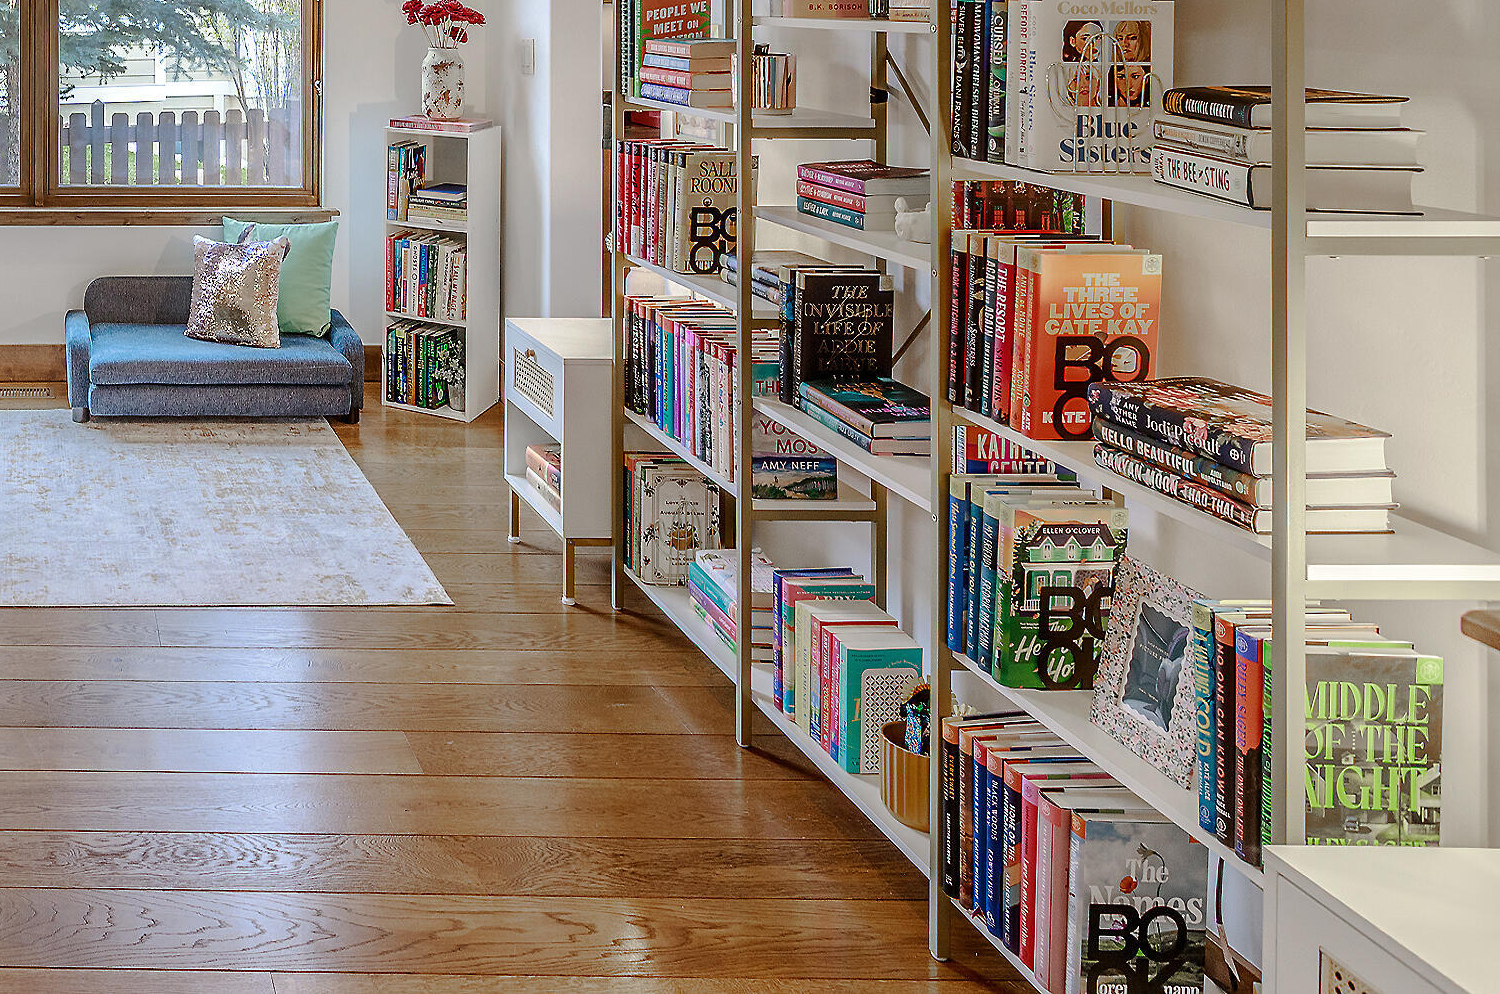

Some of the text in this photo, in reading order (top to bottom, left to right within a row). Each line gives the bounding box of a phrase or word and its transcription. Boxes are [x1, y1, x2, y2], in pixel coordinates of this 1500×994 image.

[646, 0, 707, 22] PEOPLE WE
[828, 3, 863, 11] BORISON
[958, 5, 966, 34] SILVER
[1057, 0, 1158, 15] Coco Mellors
[653, 19, 699, 36] MEET ON
[972, 4, 982, 63] MADWOMAN
[1020, 4, 1028, 40] BEFORE
[993, 15, 1004, 66] CURSED
[1019, 48, 1027, 83] FORGET
[972, 64, 981, 106] CHELSEA
[953, 75, 963, 139] DANI FRANCIS
[1185, 98, 1235, 120] PERCIVAL EVERETT
[1076, 113, 1138, 139] Blue
[1059, 138, 1152, 164] Sisters
[700, 161, 737, 177] SALL
[1167, 157, 1230, 192] THE BEE STING
[691, 177, 738, 194] ROON
[986, 259, 996, 292] AGAIN
[1082, 272, 1121, 287] THE
[831, 285, 869, 300] THE
[994, 267, 1008, 343] THE RESORT
[1063, 287, 1139, 303] THREE
[804, 303, 893, 318] INVISIBLE
[984, 306, 995, 338] AGAIN
[1049, 303, 1150, 319] LIVES OF
[813, 321, 884, 336] LIFE OF
[1044, 319, 1154, 335] CATE KAY
[817, 339, 876, 354] ADDIE
[993, 349, 1003, 402] SARA OCHS
[1112, 397, 1140, 413] BY ANY
[1112, 408, 1138, 421] OTHER
[1115, 415, 1138, 429] NAME
[1145, 414, 1221, 456] Jodi Picoult
[776, 439, 826, 455] MOS
[1101, 426, 1198, 477] HELLO BEAUTIFUL
[761, 460, 820, 471] AMY NEFF
[1100, 449, 1235, 519] BANYAN MOON THAO THAI
[1042, 526, 1101, 535] ELLEN O'CLOVER
[982, 522, 993, 571] MY FRIENDS
[969, 562, 975, 574] OF
[978, 577, 992, 651] FREDRIK BACKMAN
[1049, 620, 1068, 633] The
[1236, 661, 1247, 748] RILEY SAGER
[1304, 681, 1432, 725] MIDDLE
[822, 711, 830, 734] TRULY
[1196, 697, 1211, 758] COLD
[1216, 644, 1225, 794] NO ONE CAN KNOW
[1304, 722, 1430, 765] OF THE
[1304, 764, 1428, 812] NIGHT
[990, 779, 999, 841] BLACK WOODS
[1008, 804, 1016, 862] HOME OF THE
[1125, 858, 1169, 884] The
